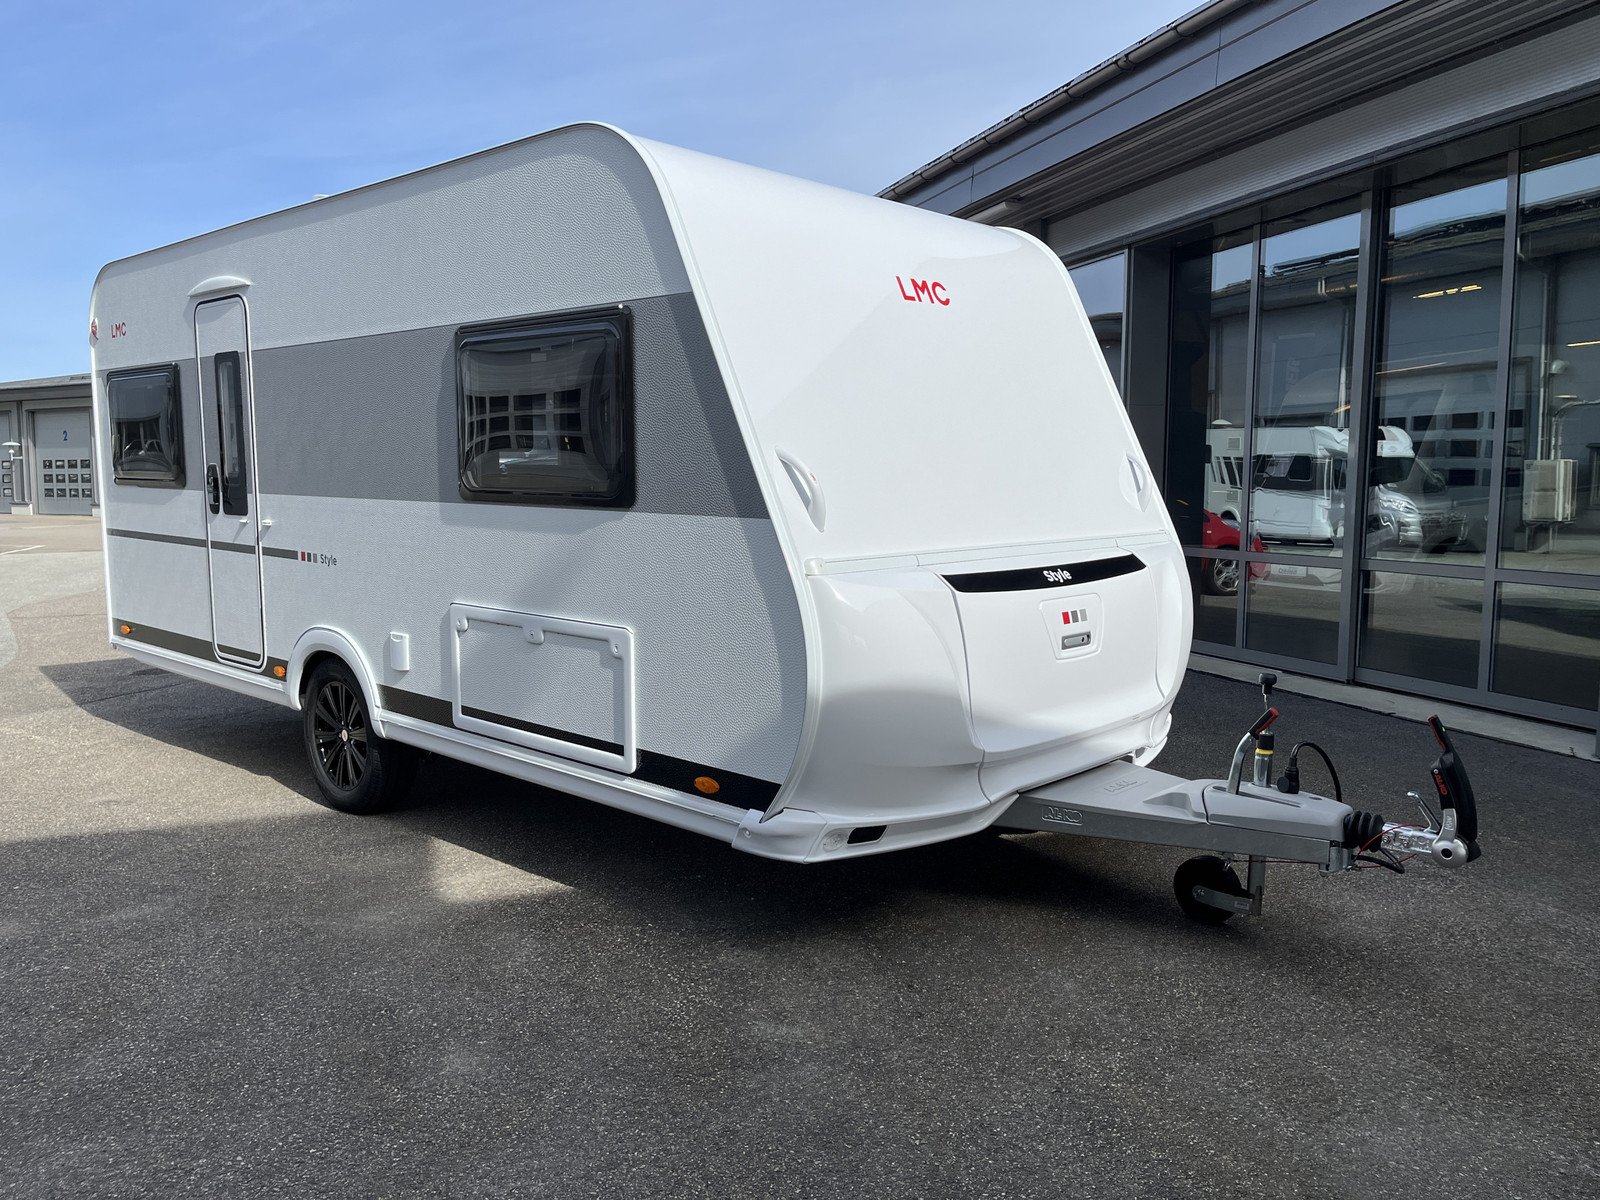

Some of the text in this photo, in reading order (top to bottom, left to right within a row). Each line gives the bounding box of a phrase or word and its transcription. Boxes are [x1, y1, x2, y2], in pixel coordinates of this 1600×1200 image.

[896, 275, 950, 306] LMC
[111, 321, 127, 338] LMC
[62, 429, 68, 441] 2
[320, 553, 337, 567] Style
[1042, 568, 1072, 583] Style
